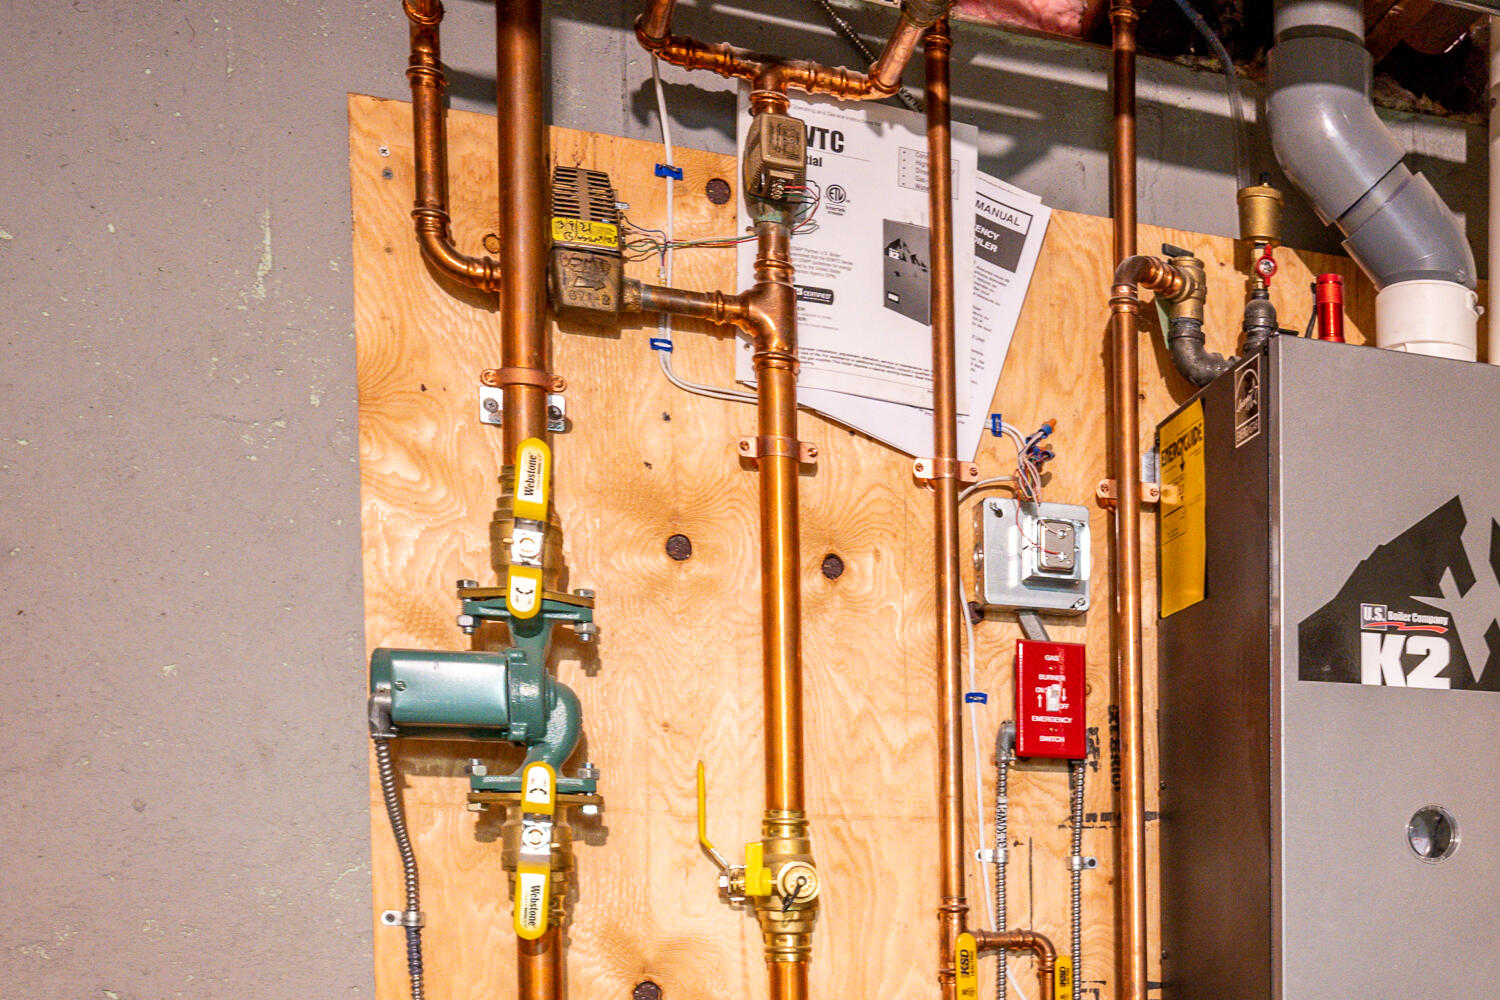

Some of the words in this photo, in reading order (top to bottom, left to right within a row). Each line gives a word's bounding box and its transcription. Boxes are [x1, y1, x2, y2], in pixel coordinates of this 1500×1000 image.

[975, 199, 1020, 227] MANUAL
[523, 452, 536, 498] Webstone
[1363, 606, 1386, 622] U.S.
[1412, 612, 1449, 626] Company
[1360, 632, 1451, 689] K2
[530, 884, 543, 928] Webstone
[960, 948, 971, 974] KSD
